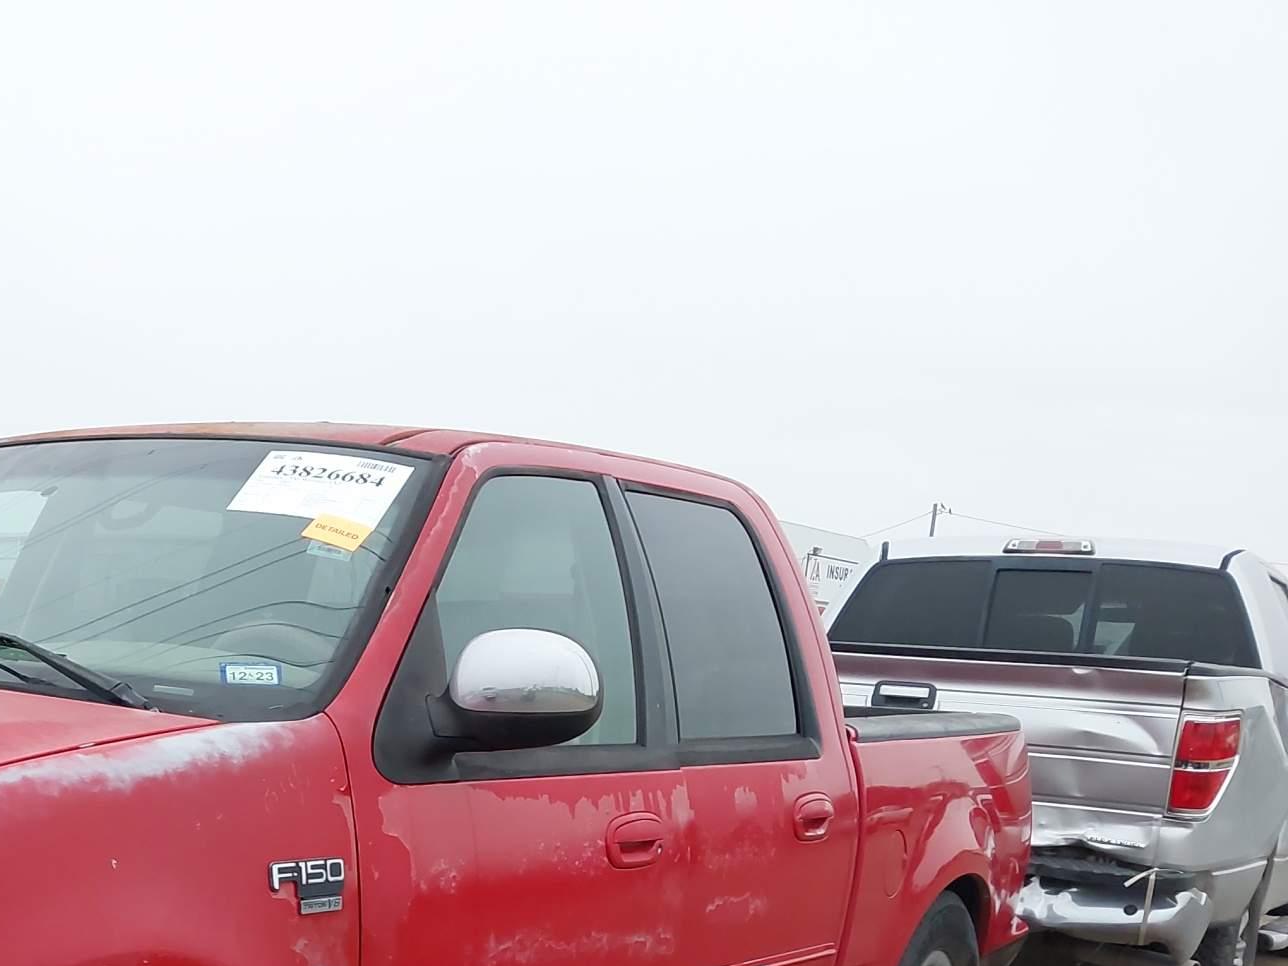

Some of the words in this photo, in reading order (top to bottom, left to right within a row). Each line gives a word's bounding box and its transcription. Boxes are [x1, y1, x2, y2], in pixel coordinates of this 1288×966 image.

[271, 463, 385, 487] 43826684
[315, 522, 359, 541] DETAILED
[229, 671, 248, 681] 12
[255, 671, 274, 681] 23
